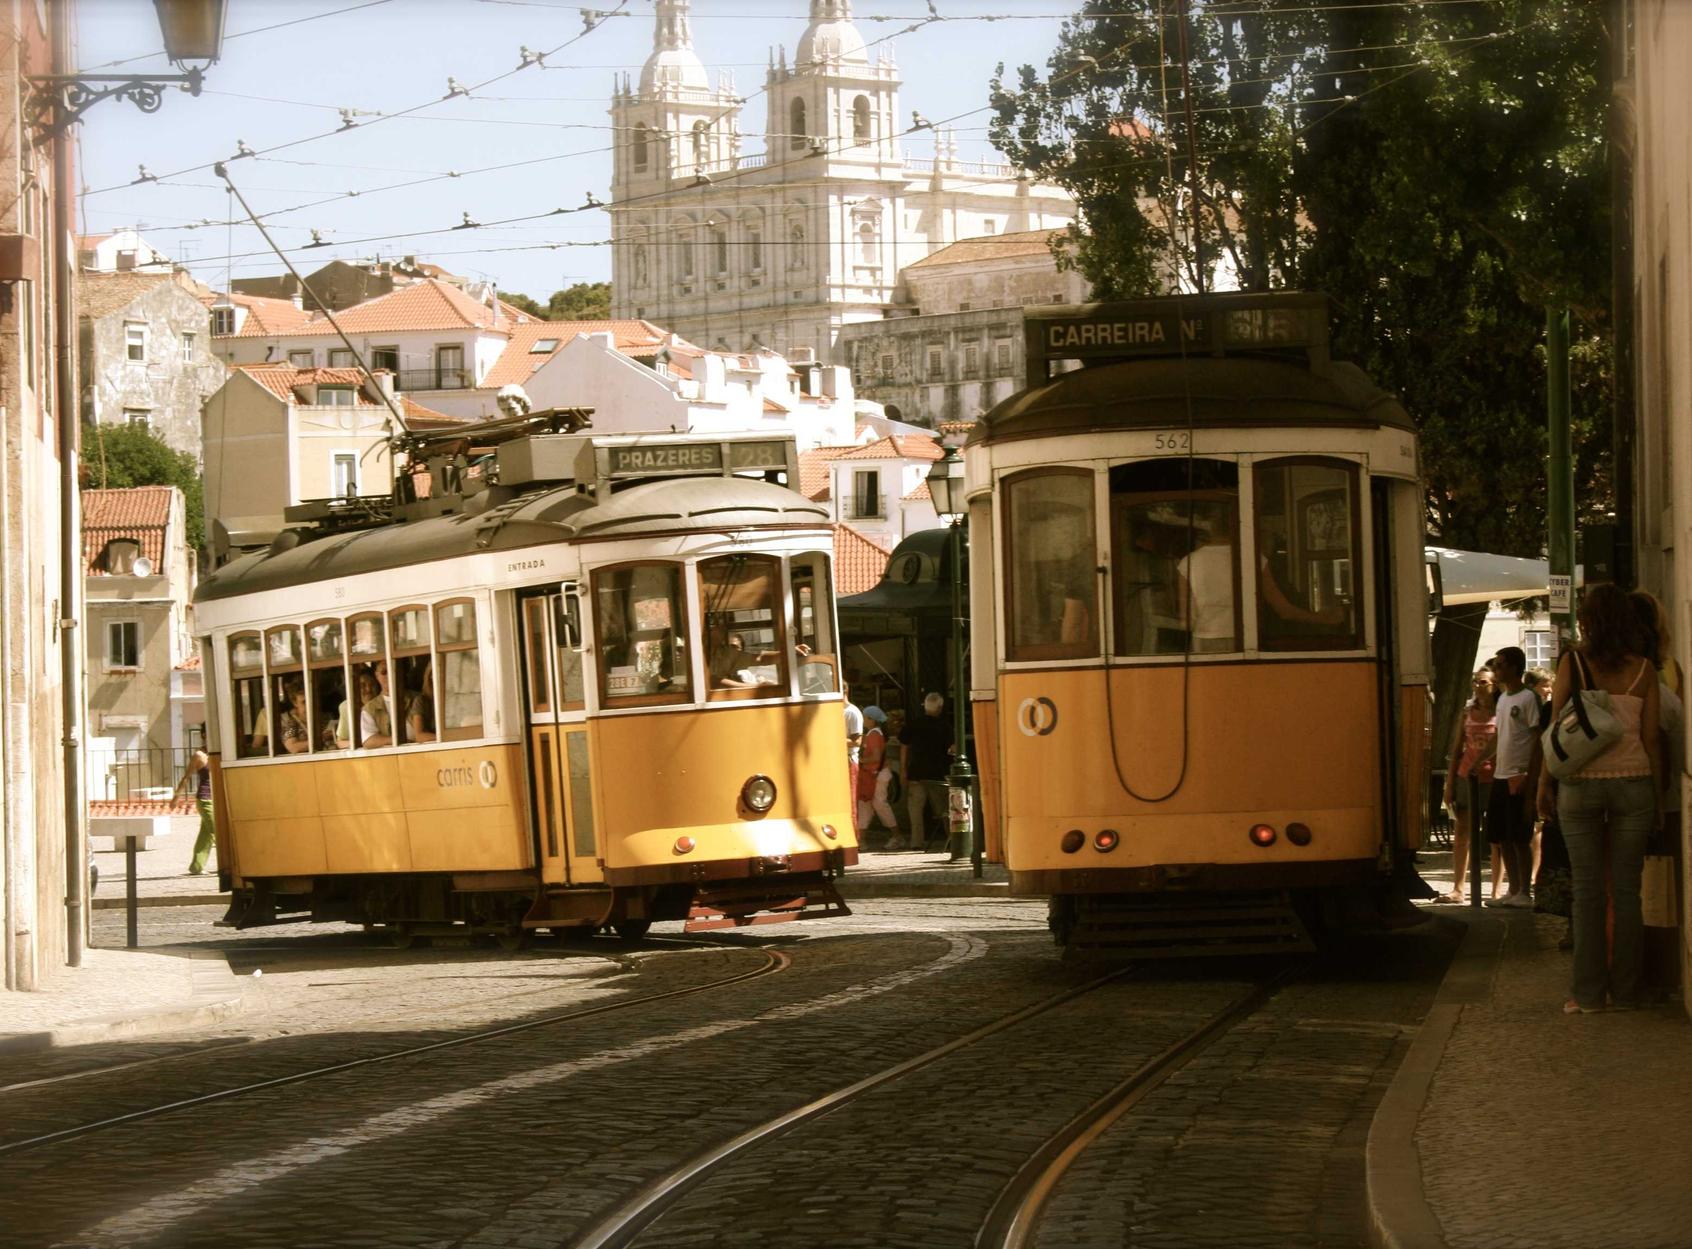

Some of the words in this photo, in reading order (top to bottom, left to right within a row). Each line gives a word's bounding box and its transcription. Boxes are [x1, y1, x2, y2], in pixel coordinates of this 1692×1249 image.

[1049, 321, 1165, 346] CARREIRA
[1155, 432, 1189, 449] 562
[618, 448, 713, 469] PRAZERES
[508, 559, 545, 572] ENTRADA
[437, 760, 473, 787] carris
